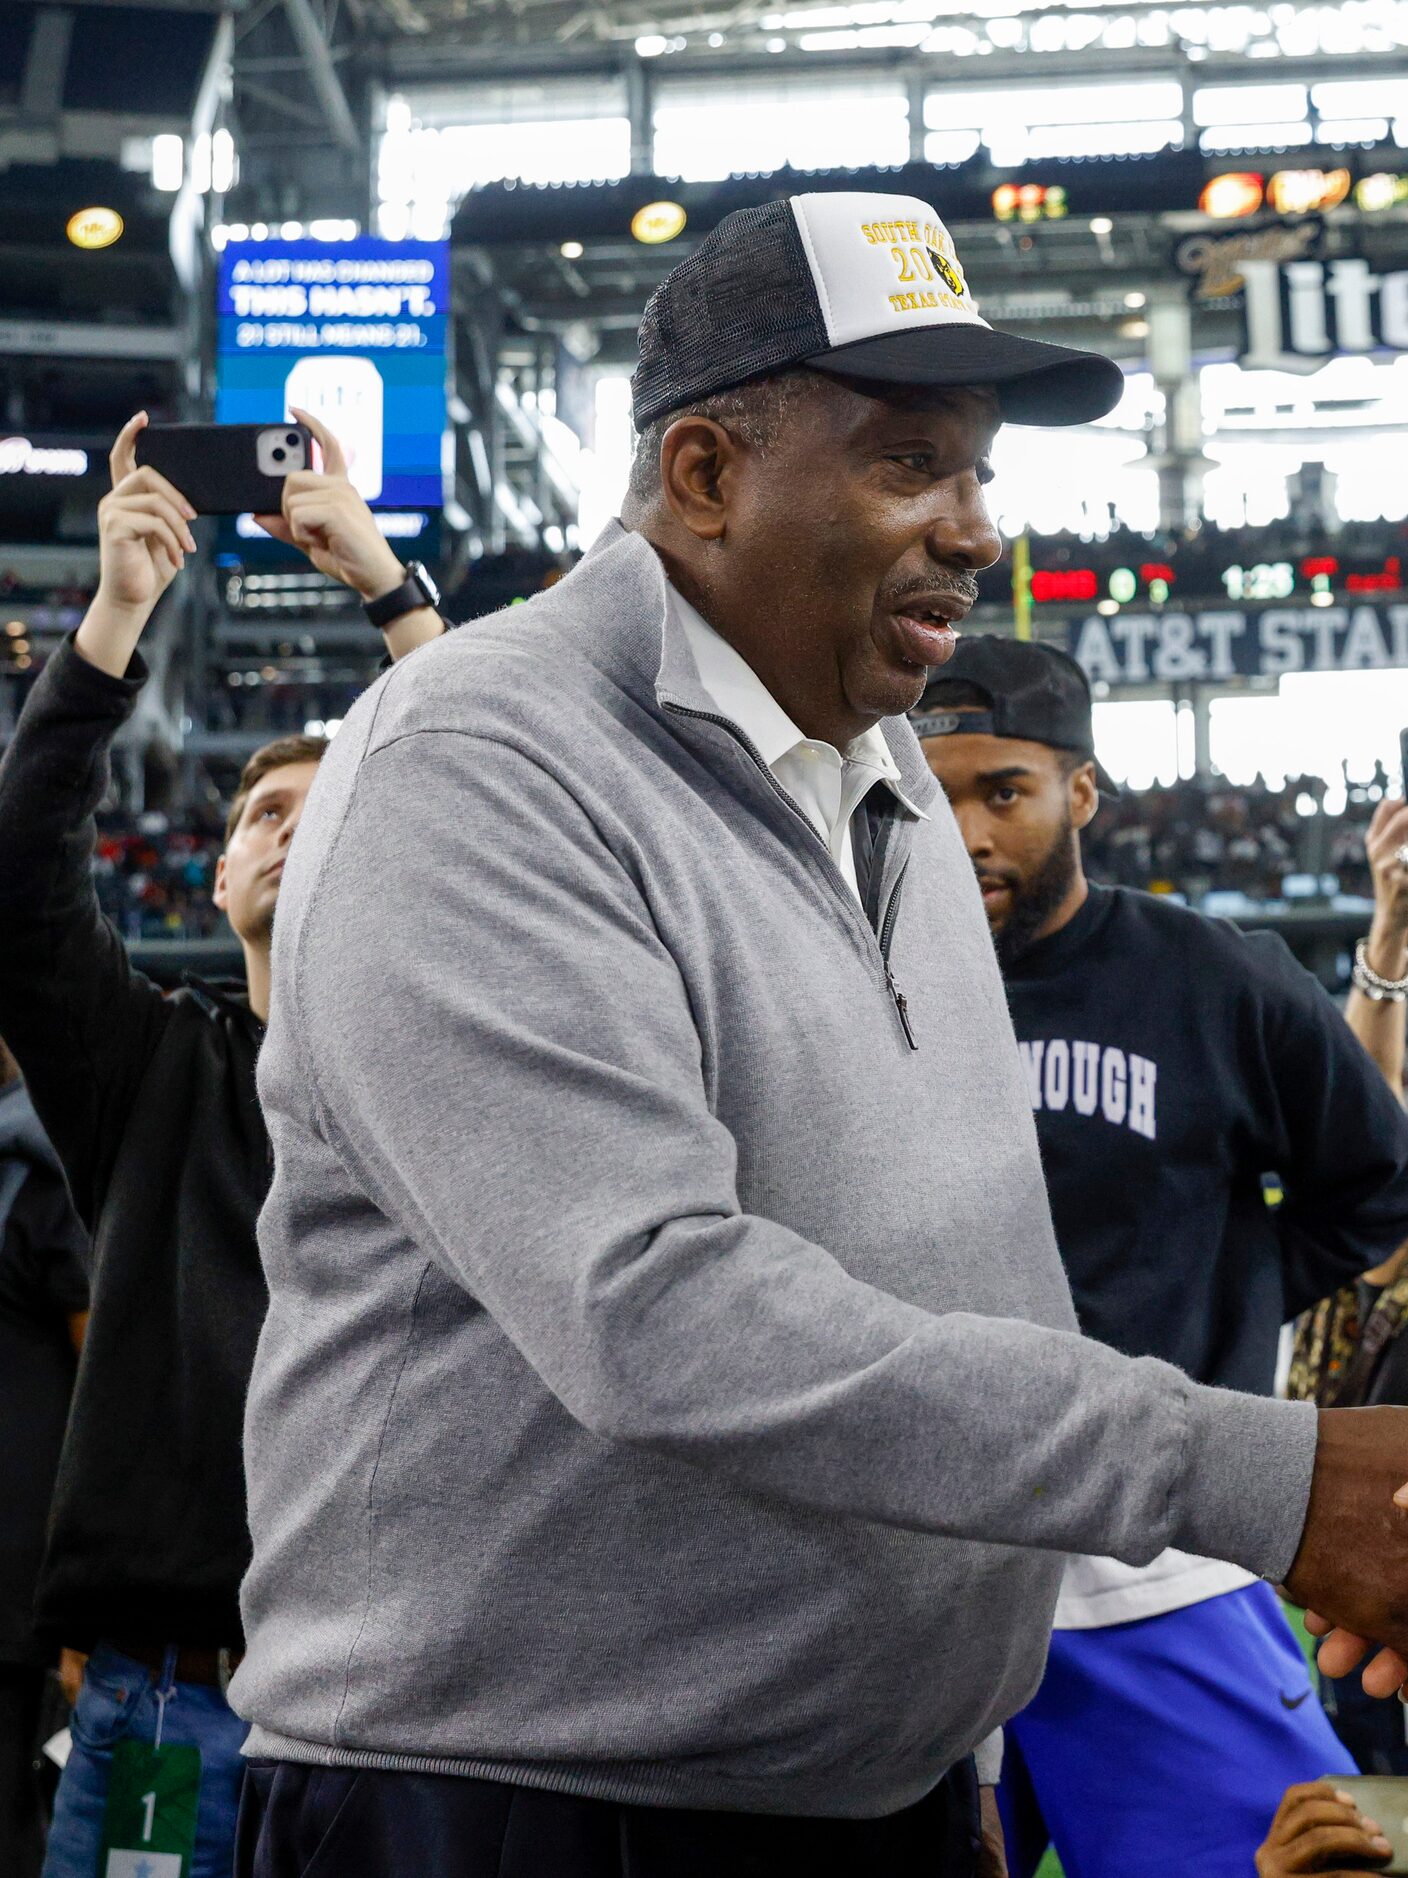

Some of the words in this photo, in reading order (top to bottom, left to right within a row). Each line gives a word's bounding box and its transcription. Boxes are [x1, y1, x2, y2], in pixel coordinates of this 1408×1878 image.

[861, 220, 921, 245] SOUTH
[889, 291, 938, 312] TEXAS
[1074, 611, 1248, 684] AT&T
[140, 1790, 157, 1842] 1
